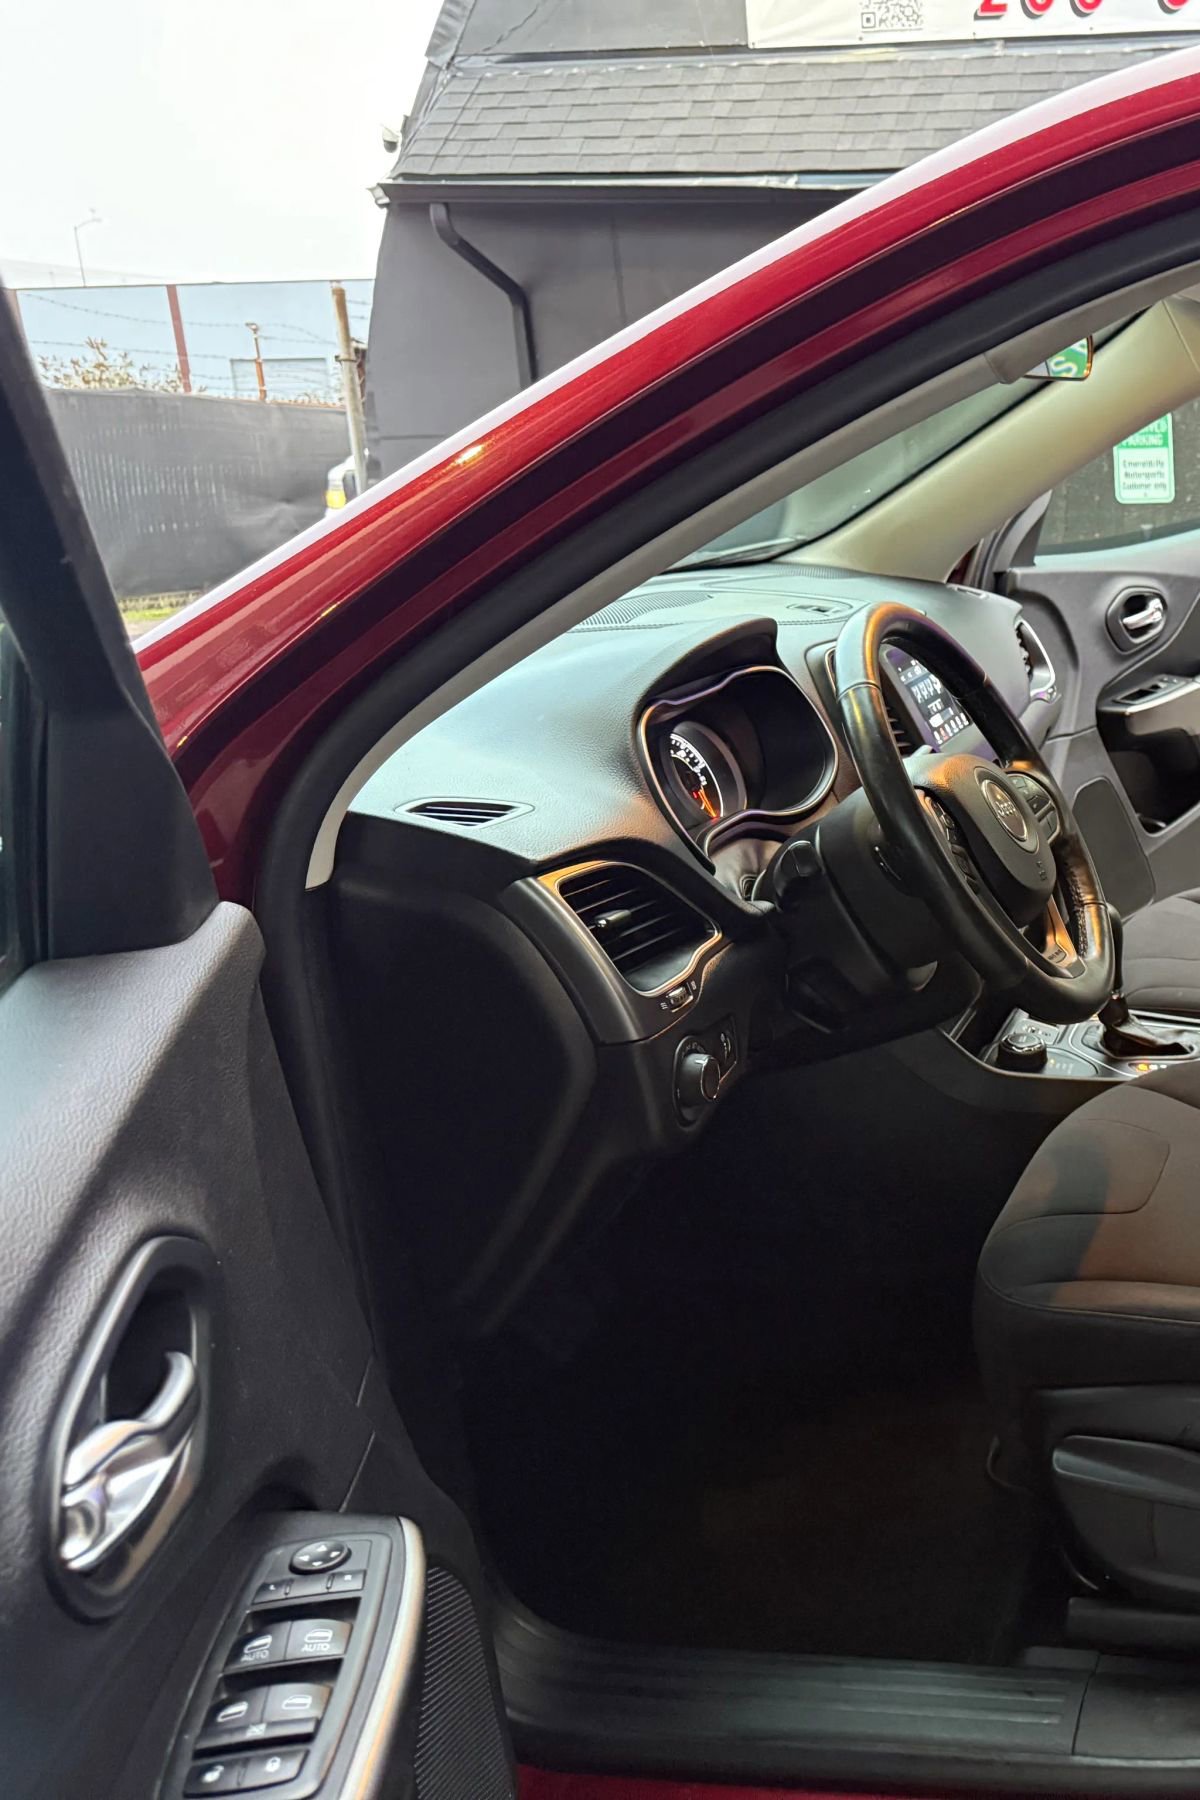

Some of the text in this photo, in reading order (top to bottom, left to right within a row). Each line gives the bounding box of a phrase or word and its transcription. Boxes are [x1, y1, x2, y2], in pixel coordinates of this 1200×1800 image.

[994, 800, 1018, 817] Jeep
[301, 1643, 330, 1652] AUTO
[240, 1650, 269, 1661] AUTO
